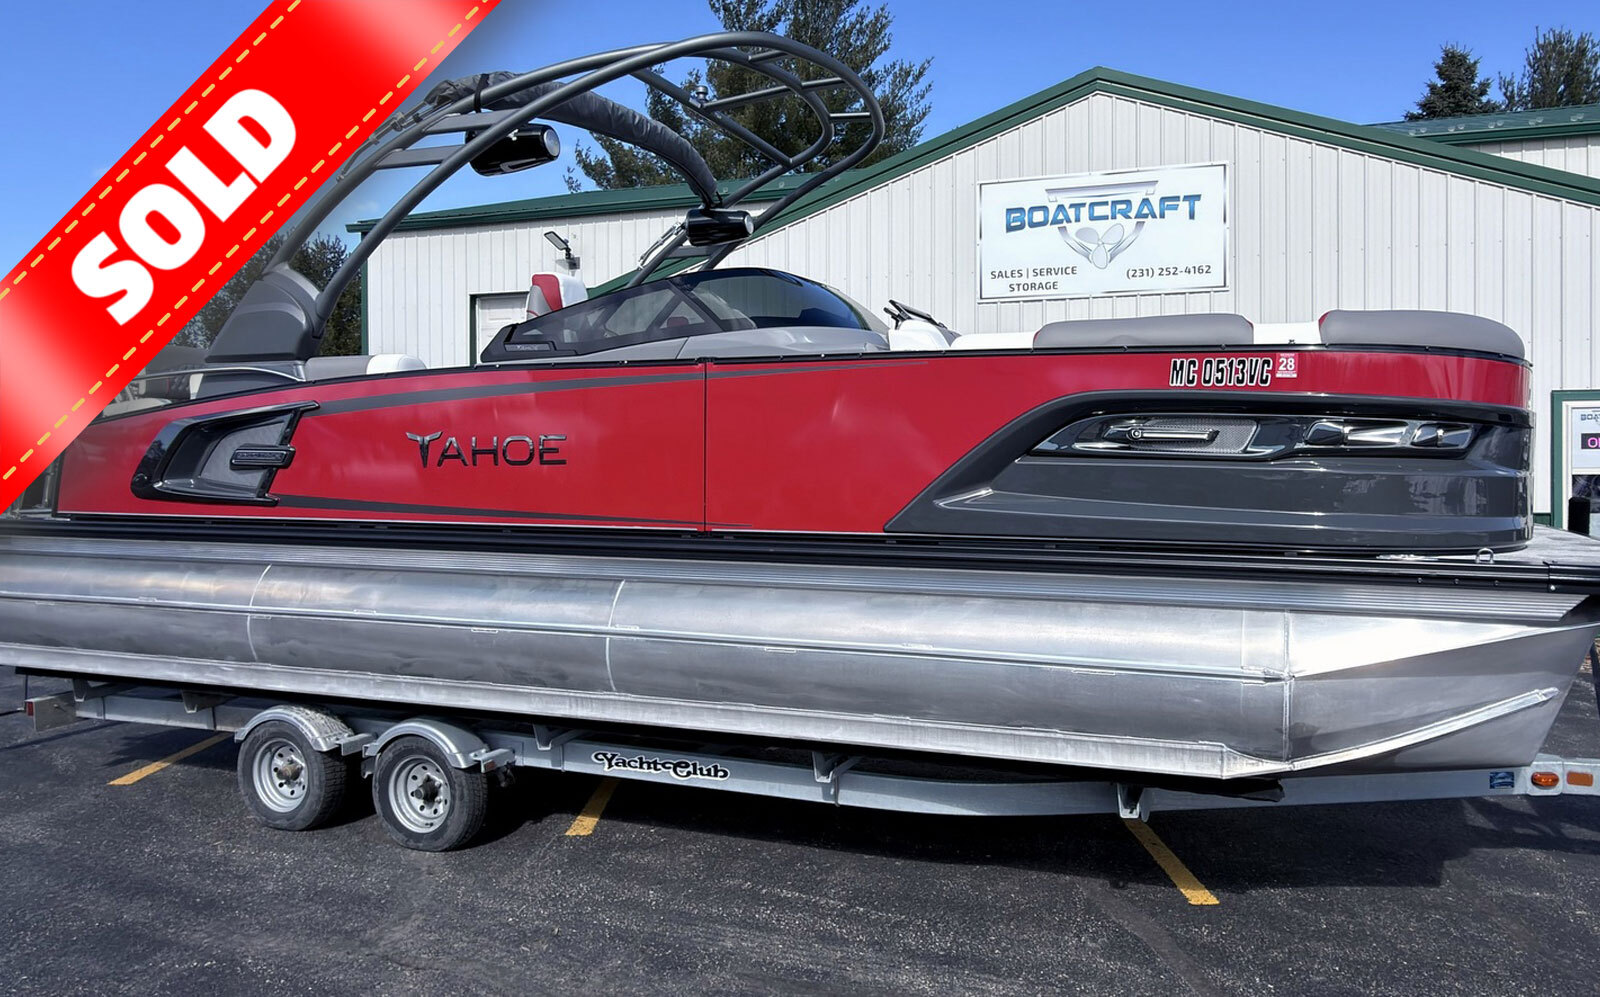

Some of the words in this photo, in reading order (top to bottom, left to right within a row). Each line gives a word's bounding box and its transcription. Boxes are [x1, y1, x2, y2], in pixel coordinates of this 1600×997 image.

[1005, 193, 1202, 233] BOATCRAFT
[990, 268, 1023, 280] SALES
[1032, 266, 1078, 278] SERVICE
[1126, 267, 1155, 280] (231)
[1158, 264, 1212, 277] 252-4162
[1009, 281, 1059, 292] STORAGE
[1170, 358, 1198, 386] MC
[1202, 357, 1273, 386] 0513VC
[1278, 357, 1295, 371] 28
[405, 431, 567, 468] TAHOE
